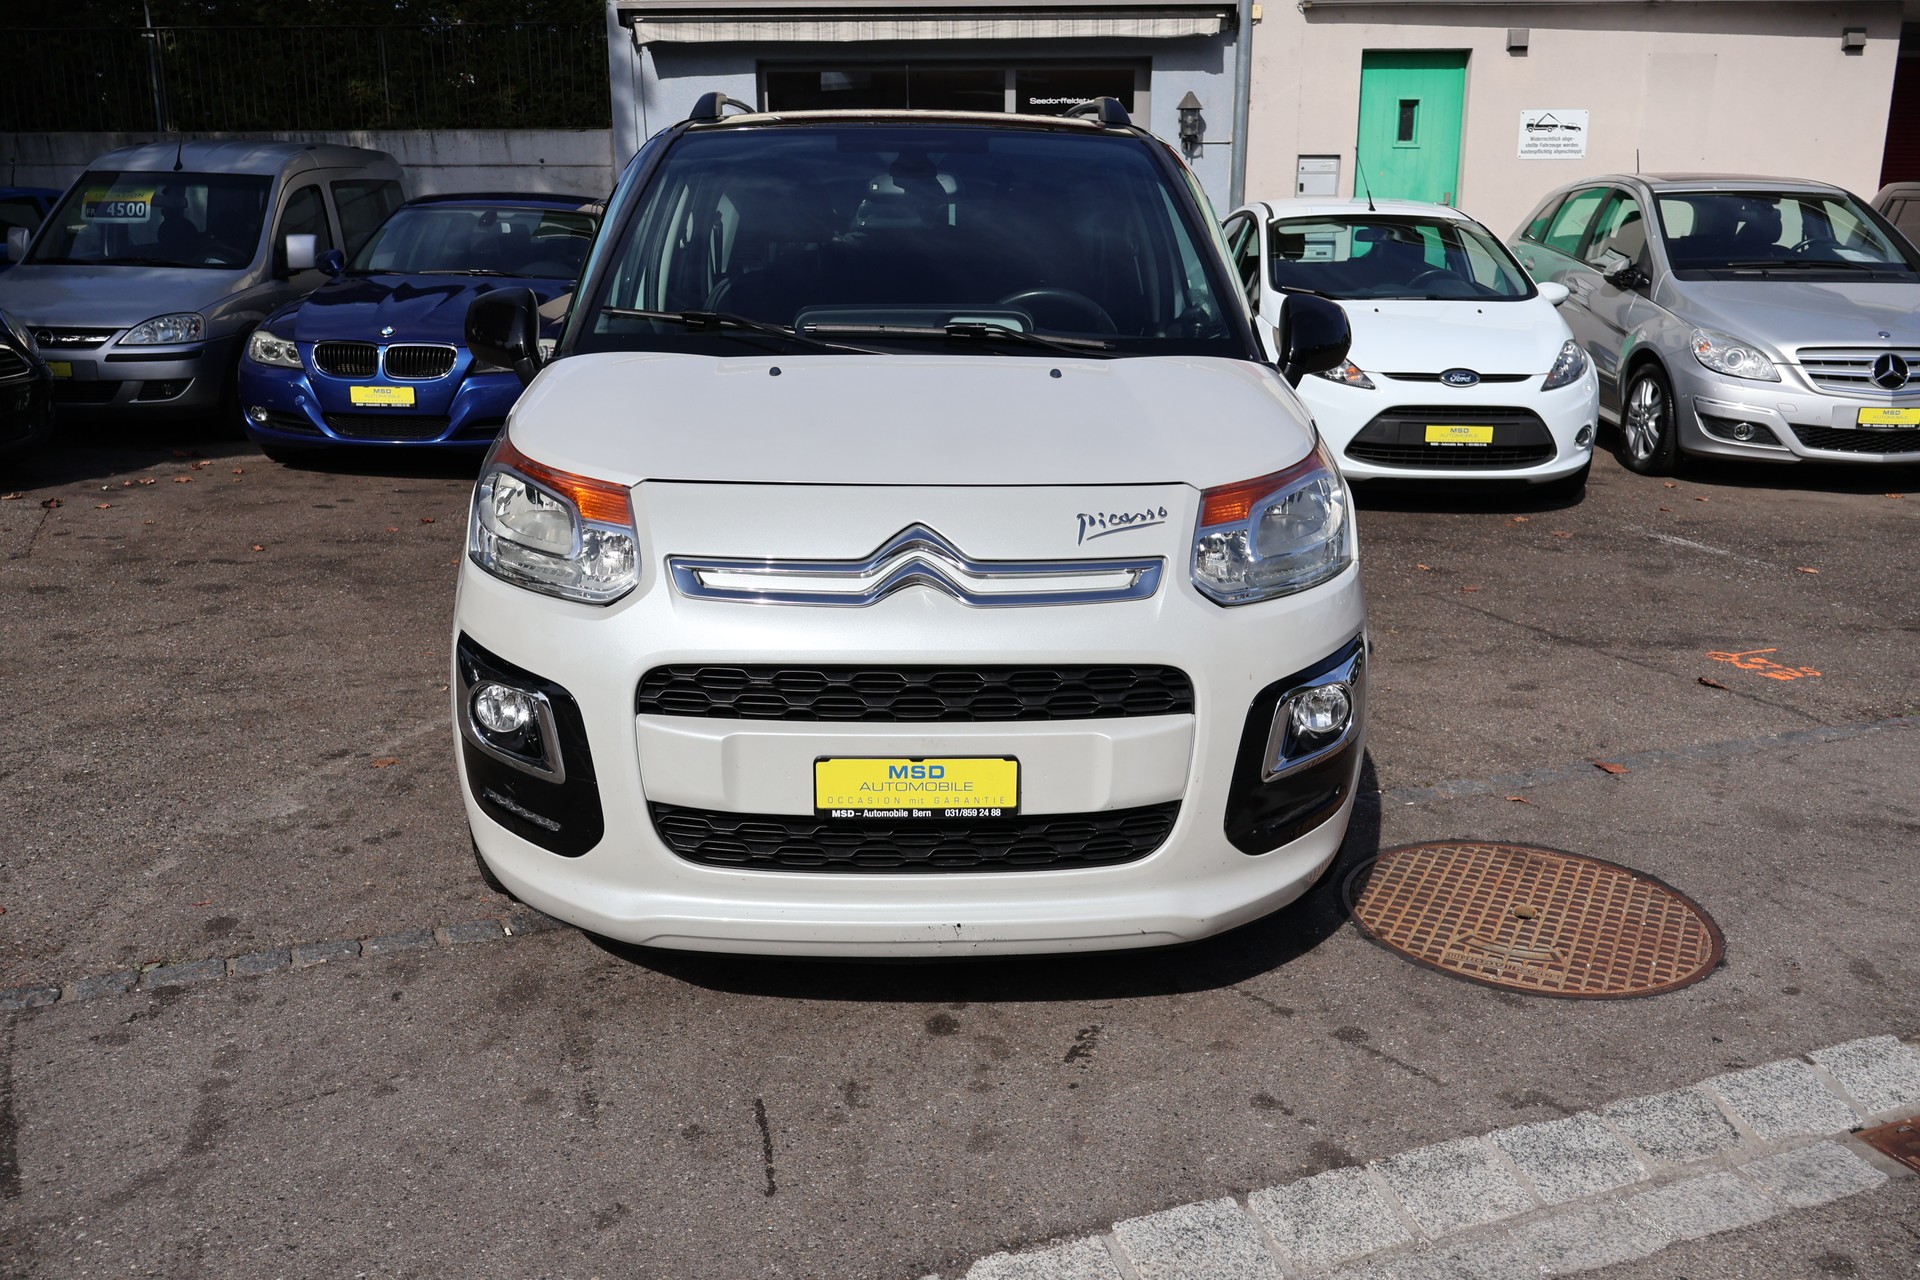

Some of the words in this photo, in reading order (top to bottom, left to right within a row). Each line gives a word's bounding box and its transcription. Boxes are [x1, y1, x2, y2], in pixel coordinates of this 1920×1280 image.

[107, 202, 145, 216] 4500
[1450, 374, 1471, 382] Ford
[888, 765, 945, 779] MSD
[859, 782, 973, 792] AUTOMOBILE
[827, 796, 901, 805] OCCASION
[909, 796, 924, 805] mit
[934, 796, 1005, 805] GARANTIE
[863, 809, 908, 818] Automobile
[912, 810, 931, 818] Bern
[945, 809, 977, 817] 031/859
[979, 809, 989, 817] 24
[991, 809, 1001, 817] 88
